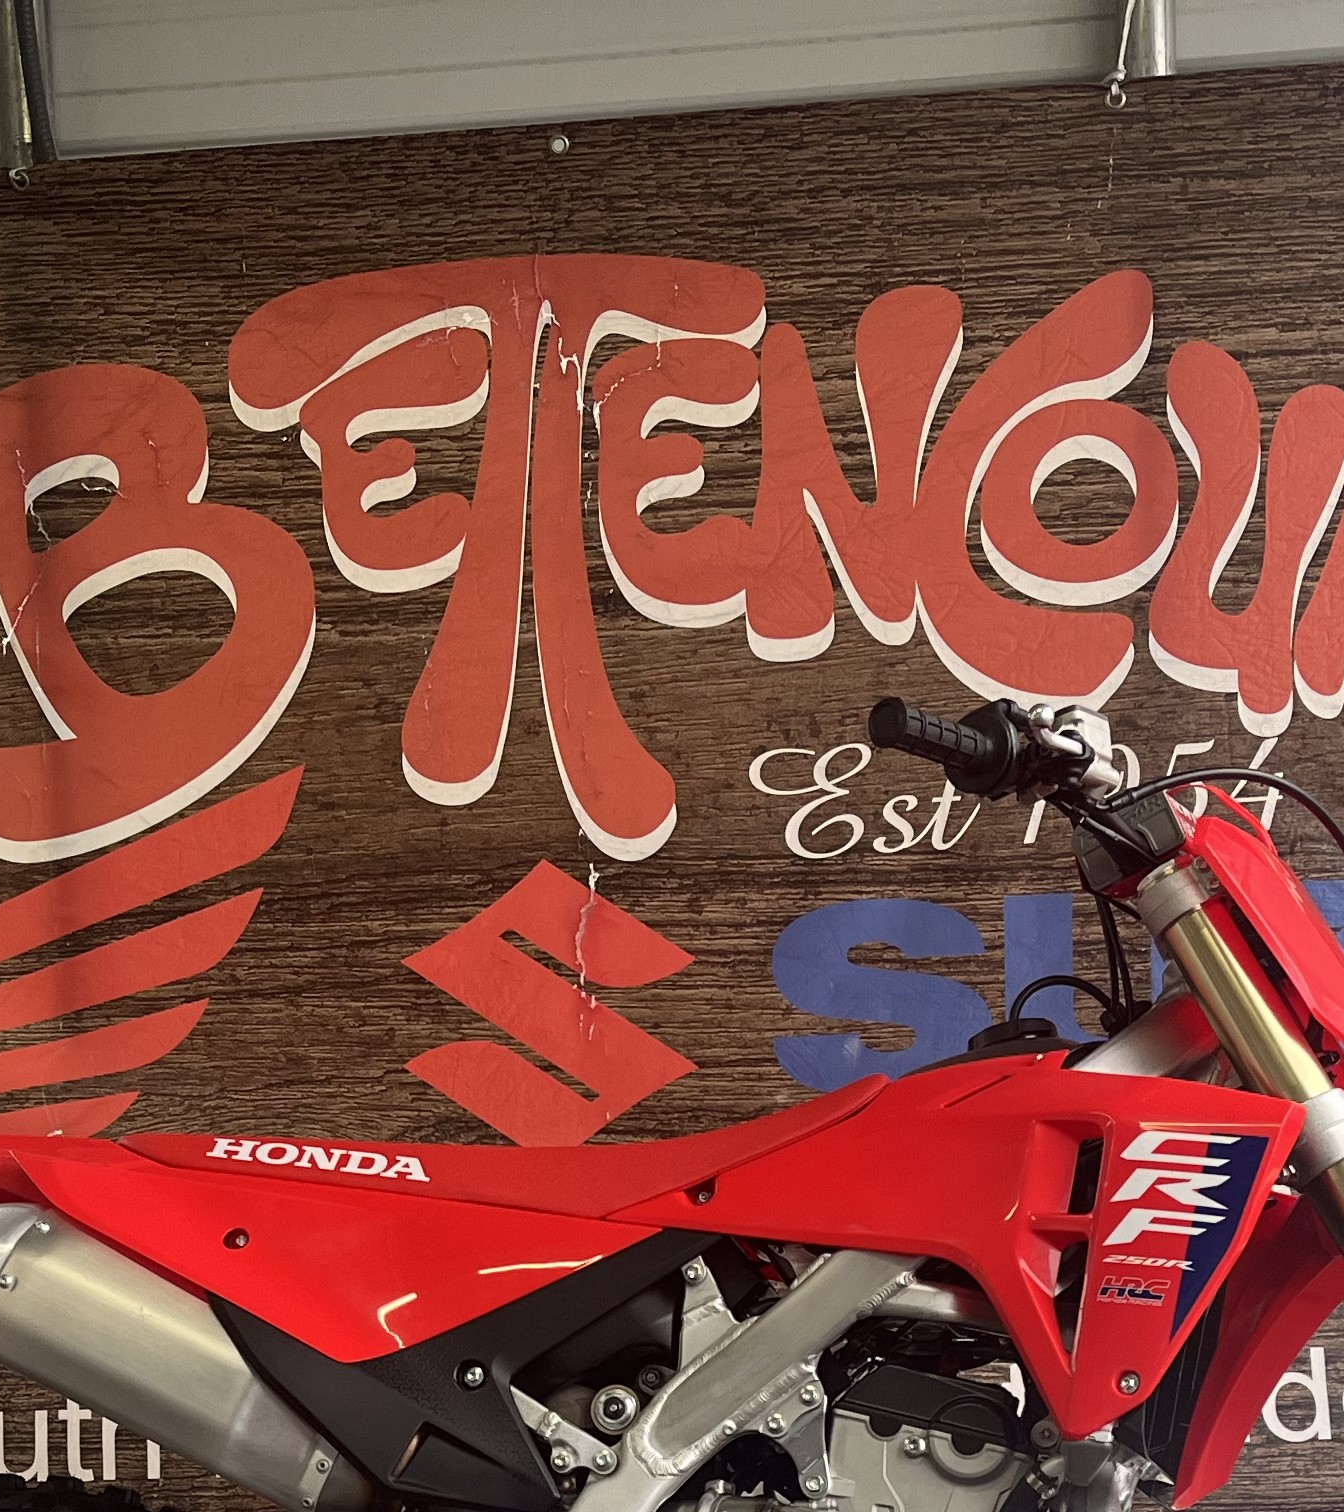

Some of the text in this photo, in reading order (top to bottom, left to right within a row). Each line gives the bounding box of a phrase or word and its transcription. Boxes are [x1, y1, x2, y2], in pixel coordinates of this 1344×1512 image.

[748, 742, 981, 860] Est
[205, 1137, 431, 1183] HONDA
[1102, 1254, 1196, 1272] 250R
[1097, 1275, 1172, 1301] HRC
